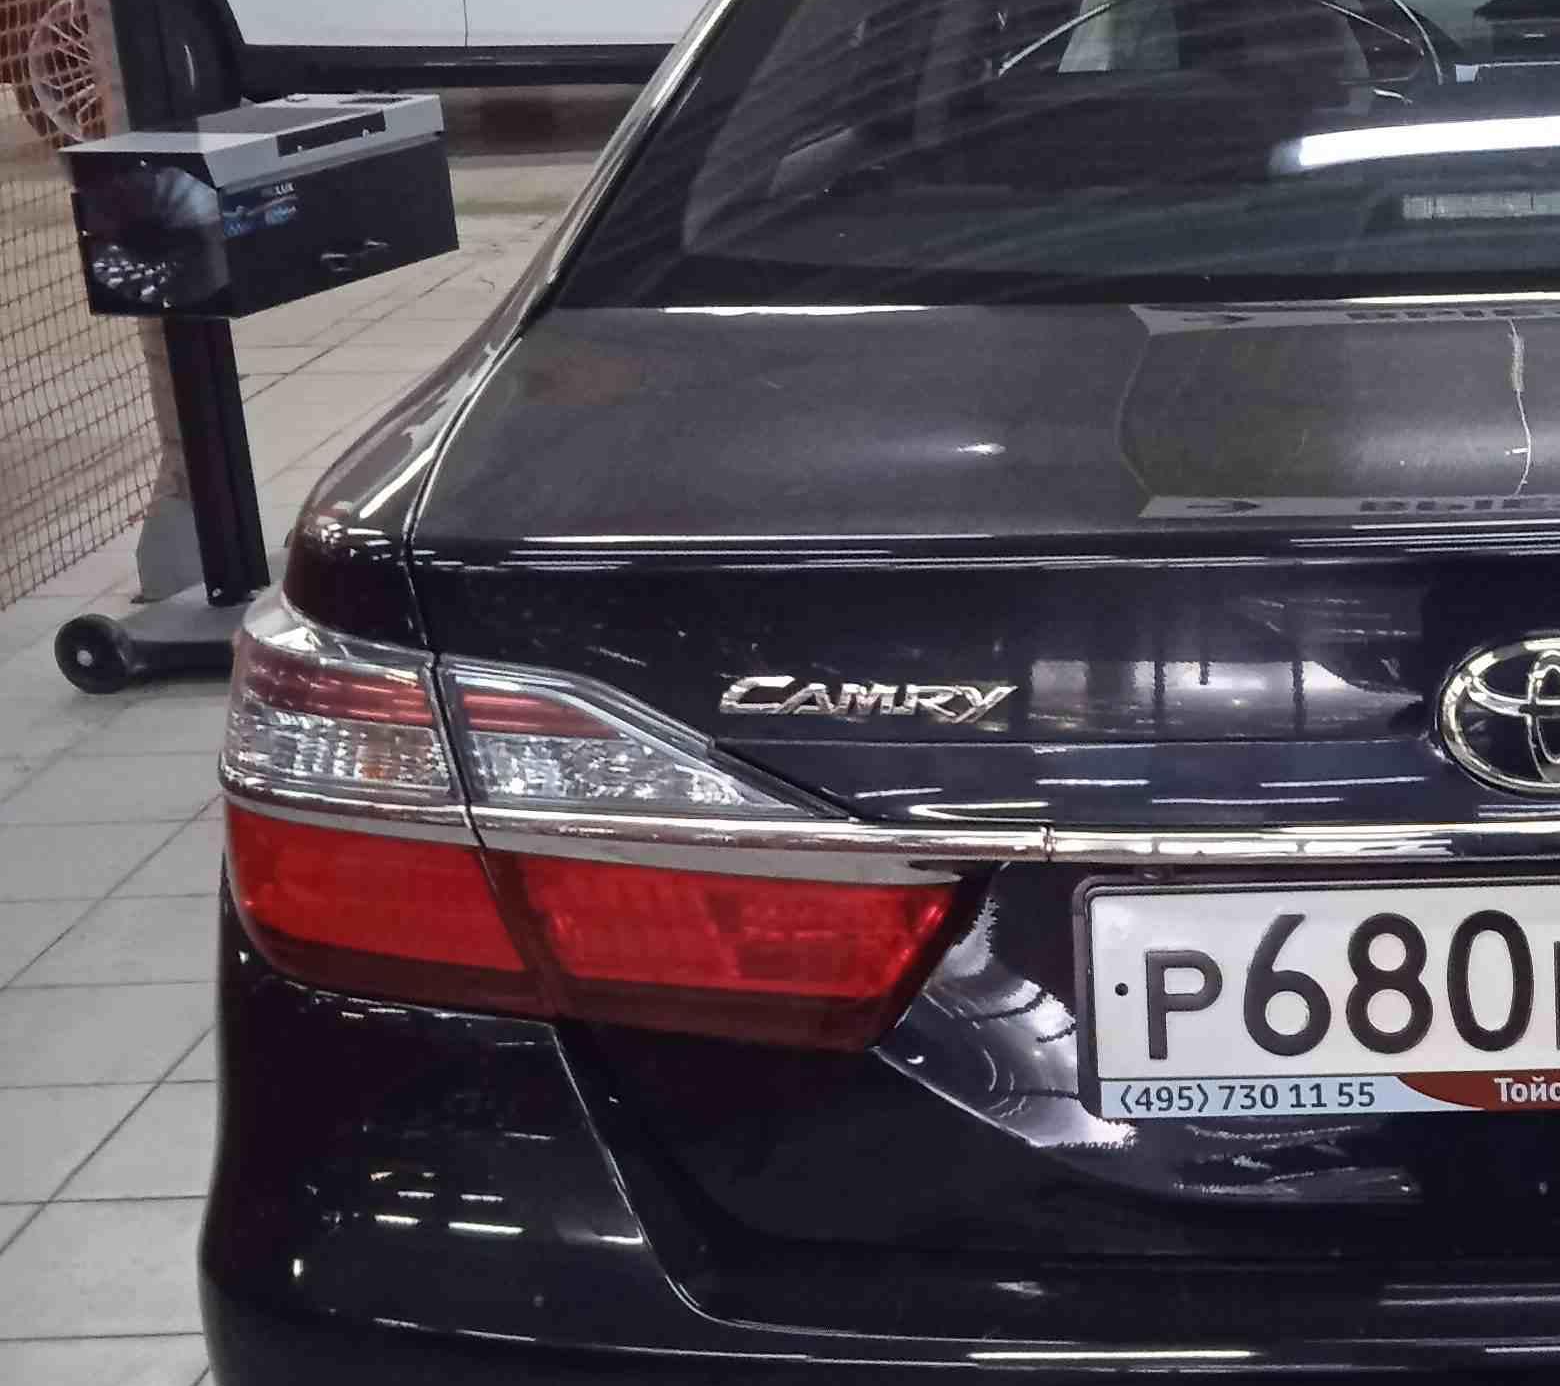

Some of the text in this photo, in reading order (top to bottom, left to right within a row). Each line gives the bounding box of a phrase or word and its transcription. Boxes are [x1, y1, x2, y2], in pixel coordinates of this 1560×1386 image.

[719, 675, 1018, 724] CAMRY
[1218, 1085, 1279, 1111] 730
[1289, 1084, 1328, 1109] 11
[1337, 1082, 1376, 1108] 55
